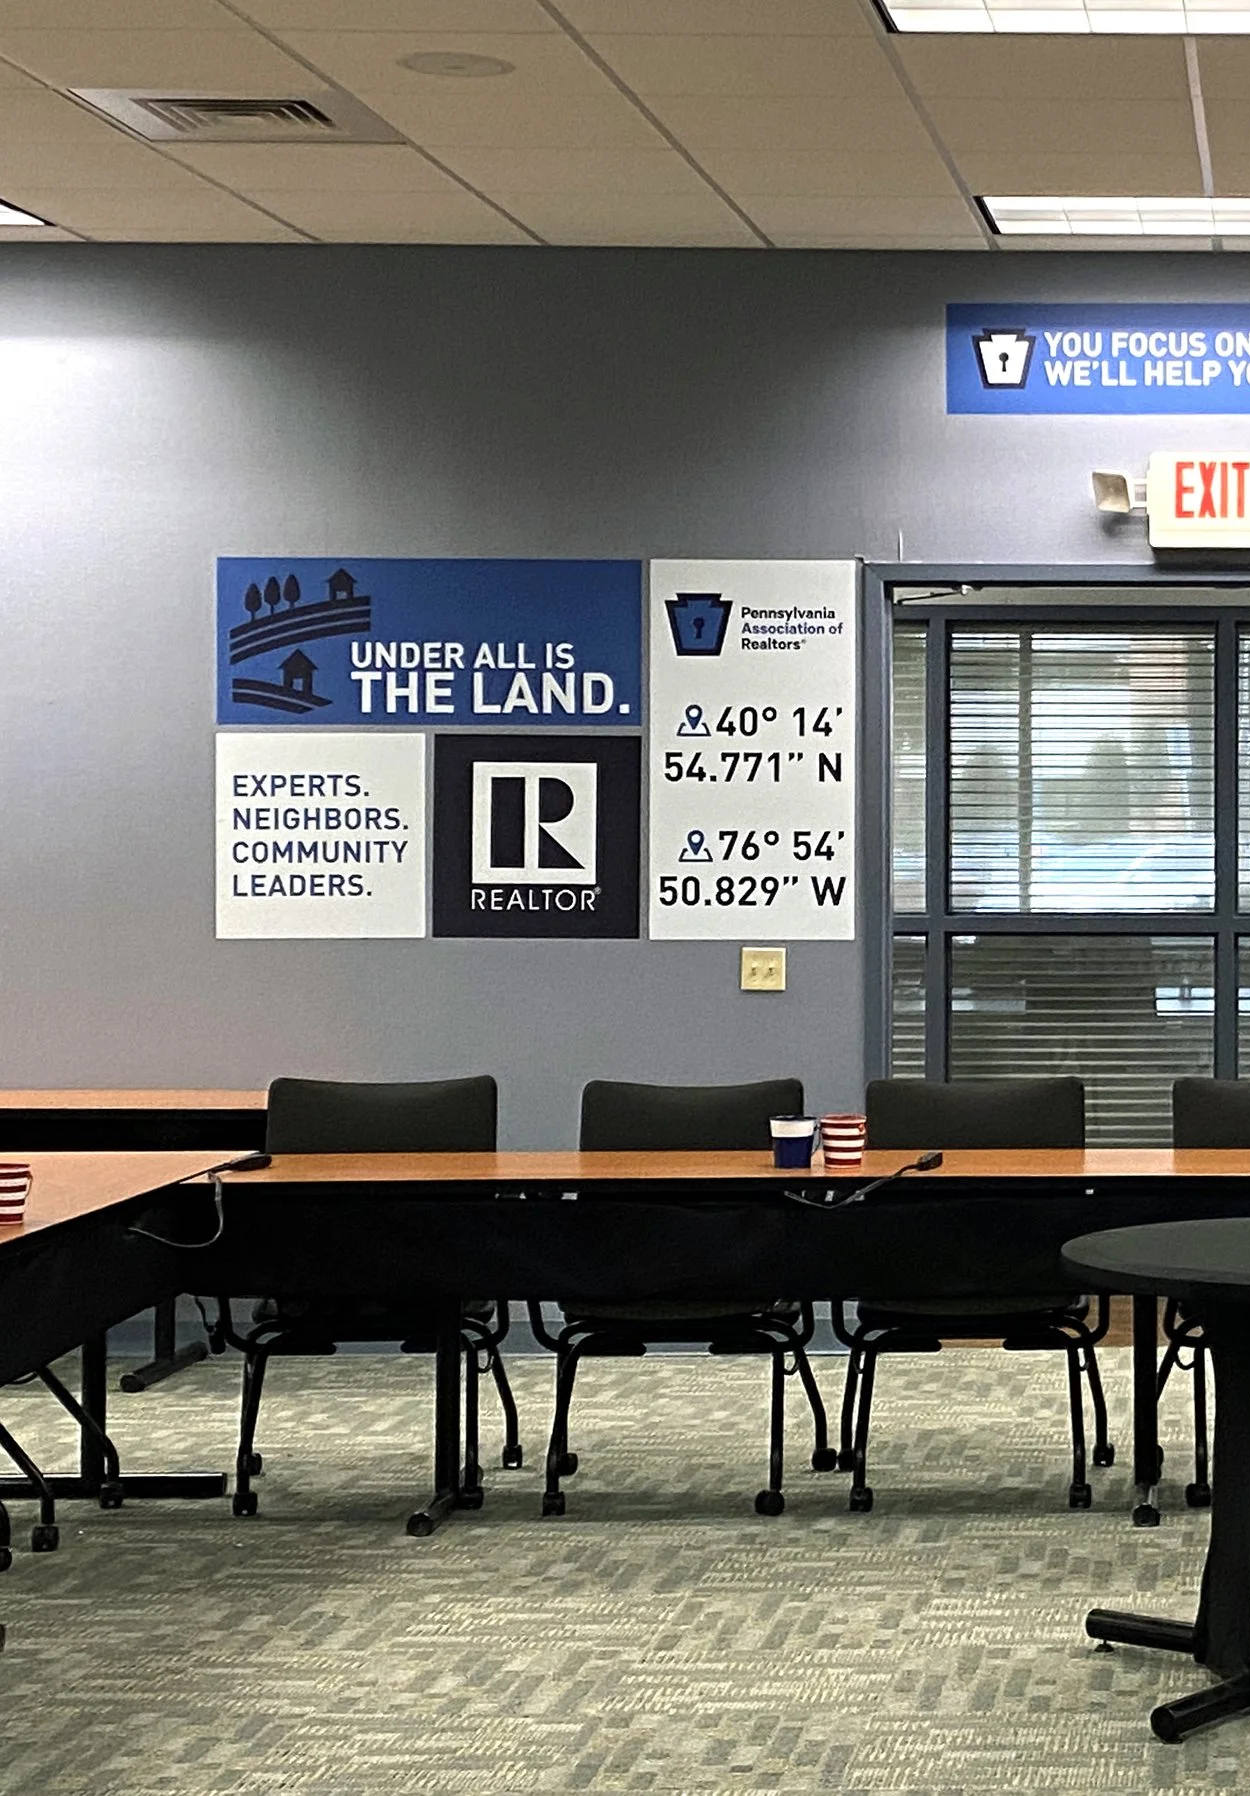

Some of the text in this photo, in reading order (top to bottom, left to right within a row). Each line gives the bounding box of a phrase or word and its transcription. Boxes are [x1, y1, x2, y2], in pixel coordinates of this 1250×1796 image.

[1044, 331, 1102, 357] YOU
[1112, 332, 1208, 357] FOCUS
[1143, 360, 1221, 386] HELP
[1175, 461, 1250, 518] EXIT
[742, 607, 835, 622] Pennsylvania
[742, 622, 843, 634] Association of
[352, 642, 574, 669] UNDER ALL IS
[351, 671, 629, 713] THE LAND.
[819, 753, 841, 782] N
[234, 775, 369, 797] EXPERTS.
[234, 808, 408, 830] NEIGHBORS.
[233, 841, 408, 863] COMMUNITY
[234, 874, 372, 896] LEADERS.
[811, 876, 846, 906] W
